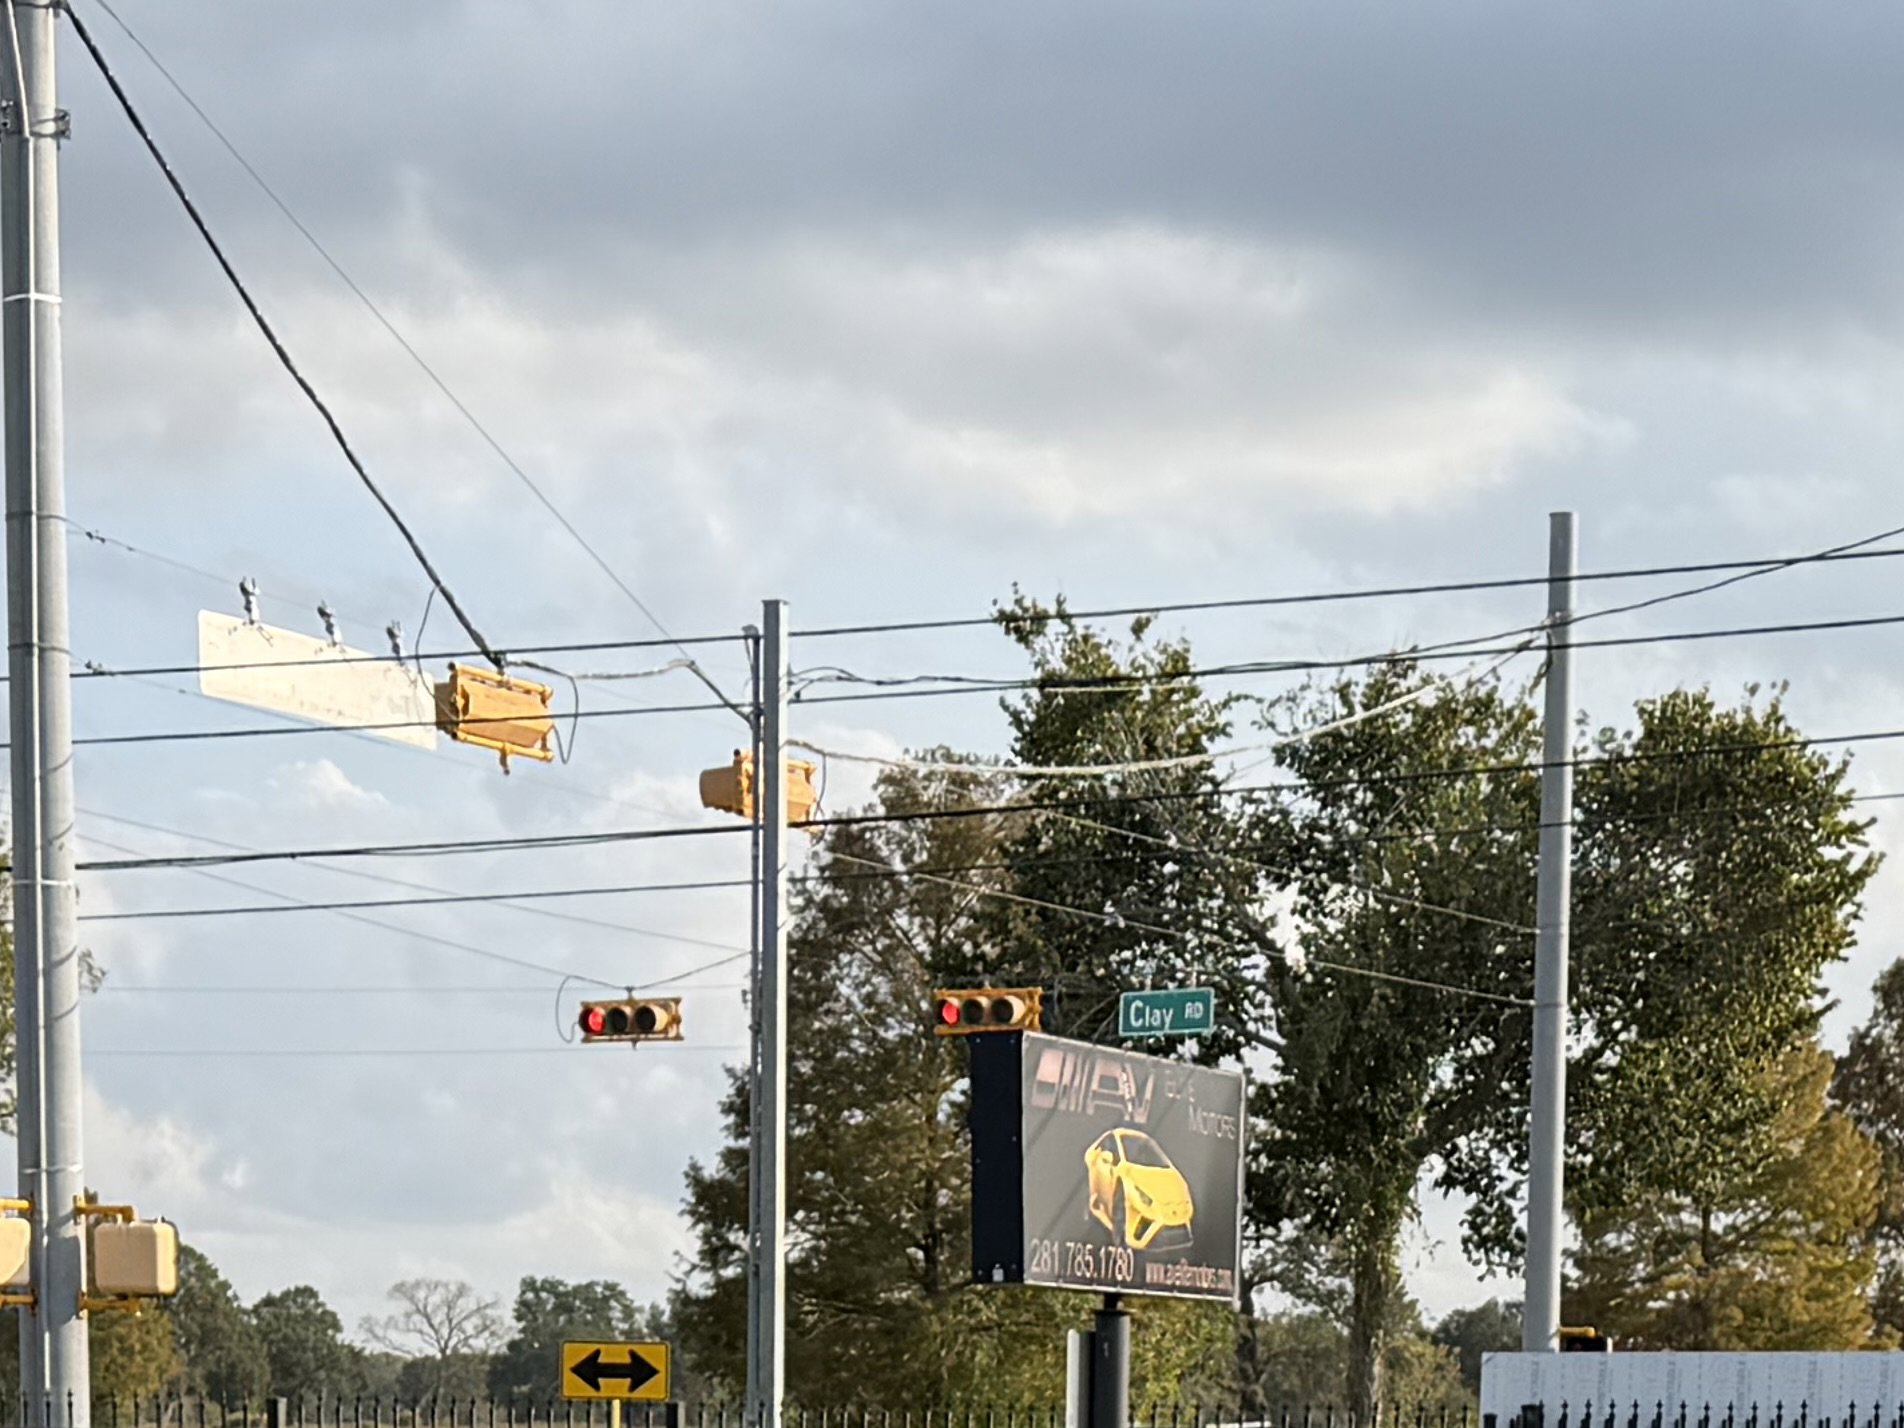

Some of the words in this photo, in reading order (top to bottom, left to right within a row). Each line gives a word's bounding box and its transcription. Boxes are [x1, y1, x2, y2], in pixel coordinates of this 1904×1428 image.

[1130, 1000, 1173, 1032] Clay
[1184, 1002, 1203, 1019] RD
[1029, 1238, 1135, 1282] 281.785.1780
